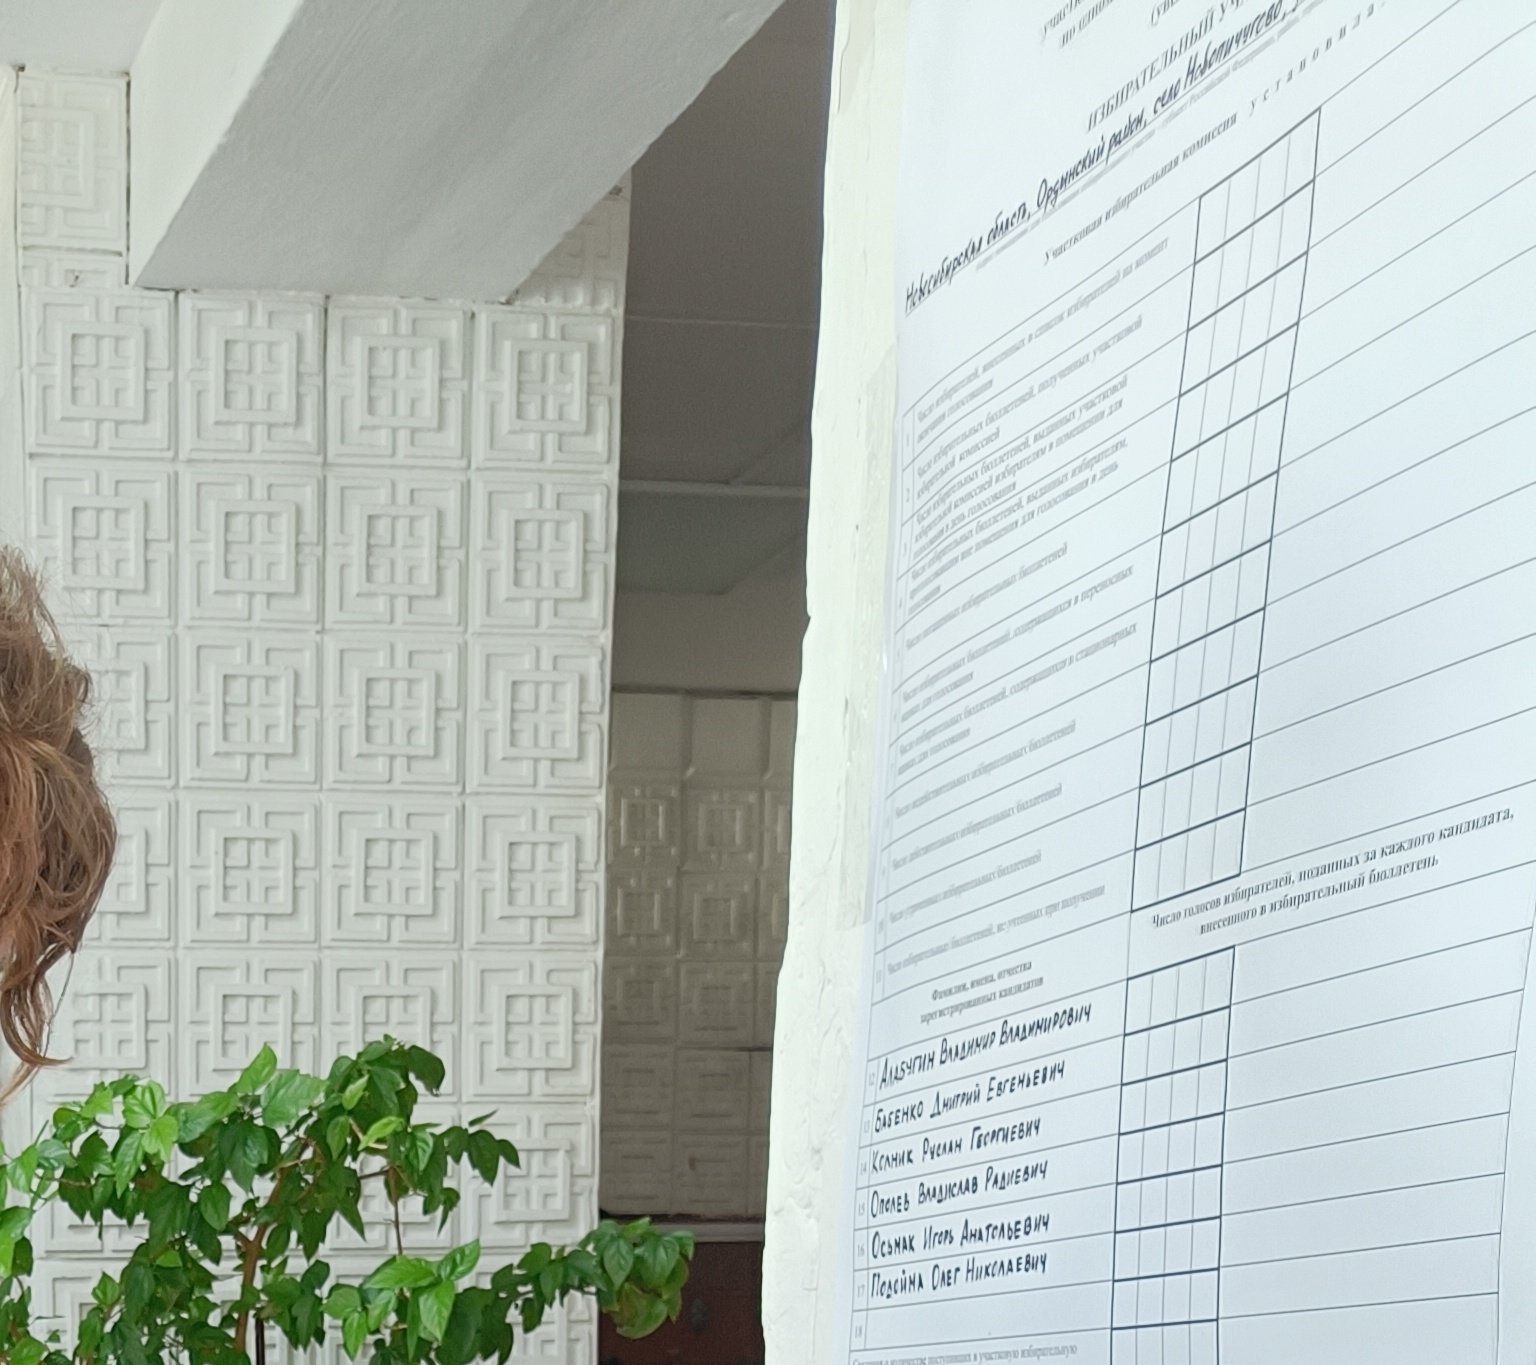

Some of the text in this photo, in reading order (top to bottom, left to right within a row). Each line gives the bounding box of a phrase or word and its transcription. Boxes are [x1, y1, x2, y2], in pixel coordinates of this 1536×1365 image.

[1087, 7, 1215, 132] ИЗБИРАТЕЛЬНЫЙ
[1181, 112, 1238, 163] комиссия
[1152, 805, 1515, 929] Число голосов избирателей, поданных за каждого кандидата,
[1199, 906, 1258, 935] внесенного
[1268, 869, 1365, 913] избирательный
[1368, 853, 1440, 885] бюллетень
